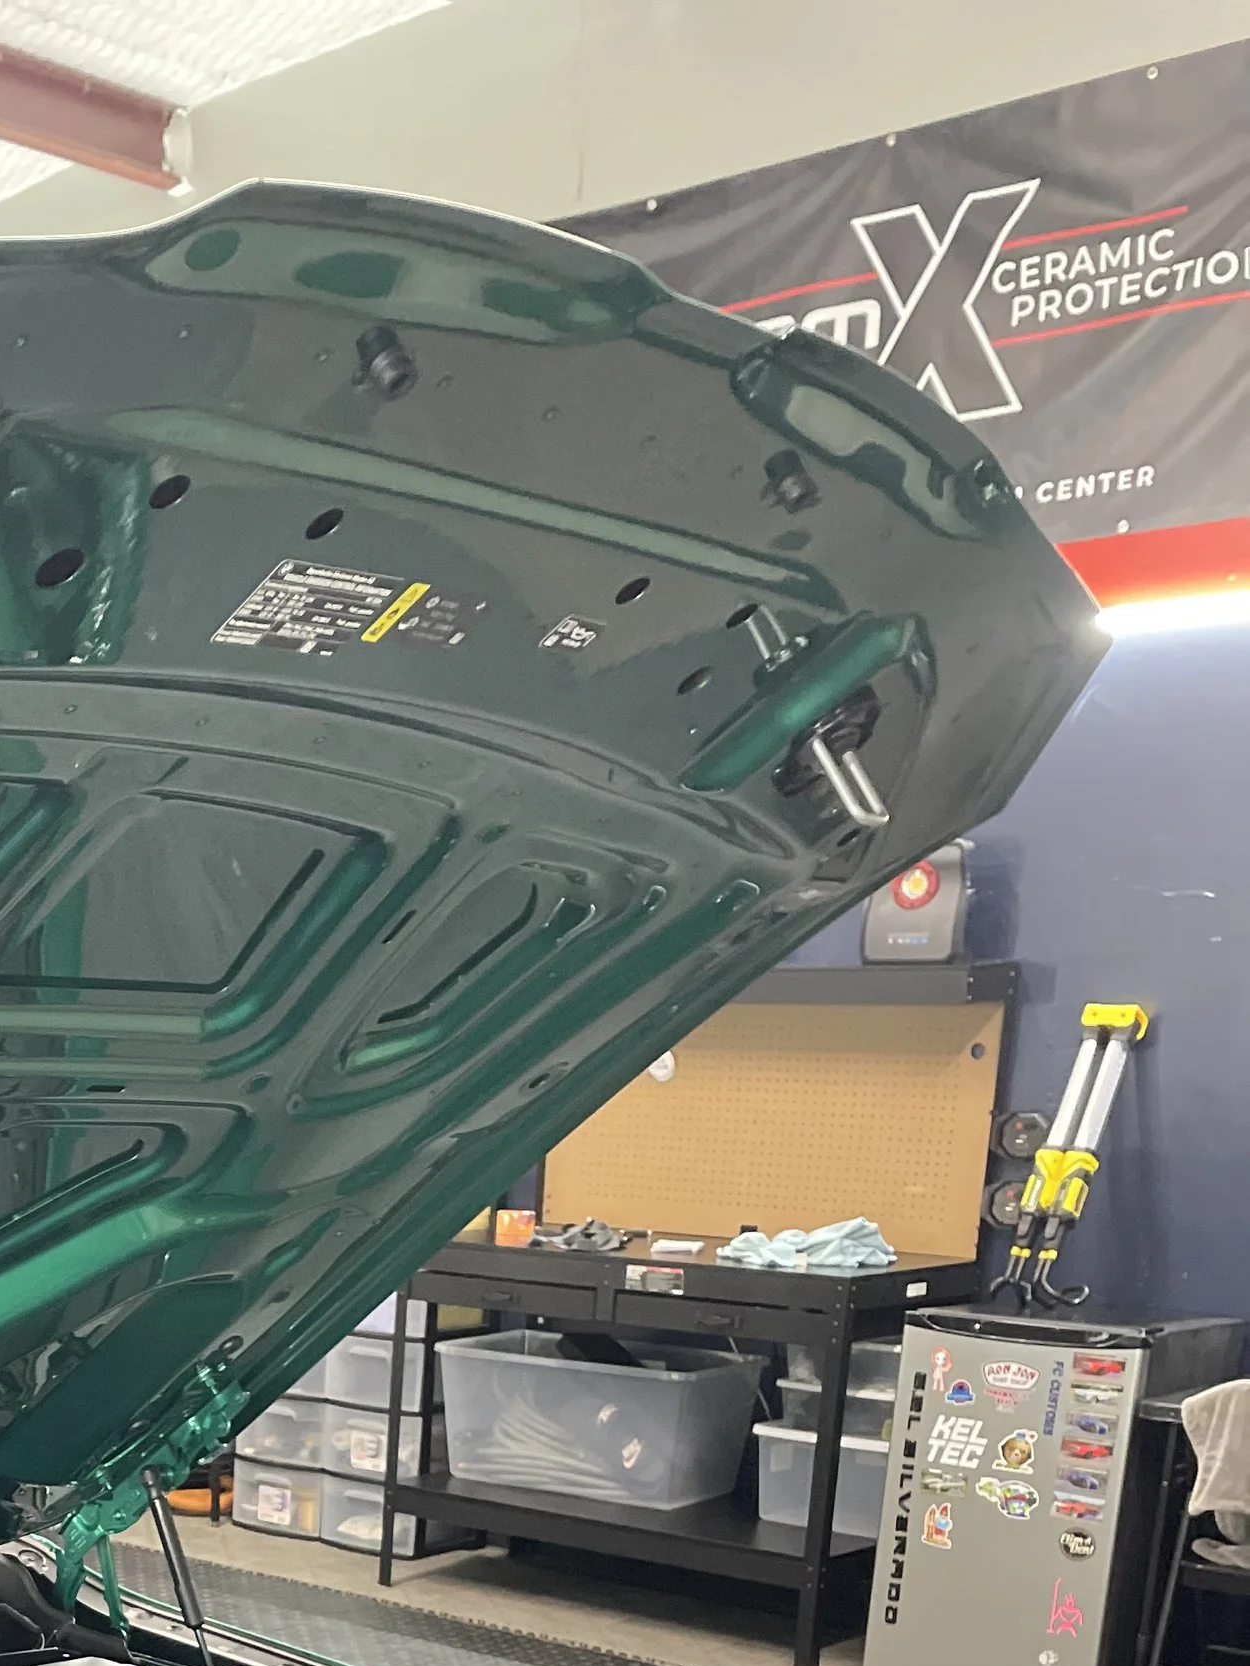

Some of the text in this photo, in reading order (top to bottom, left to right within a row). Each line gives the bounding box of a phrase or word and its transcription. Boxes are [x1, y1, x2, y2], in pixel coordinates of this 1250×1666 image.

[991, 228, 1175, 293] CERAMIC
[1035, 465, 1155, 504] CENTER
[987, 1364, 1036, 1380] RON JON
[931, 1413, 988, 1446] KEL
[926, 1438, 986, 1469] TEC
